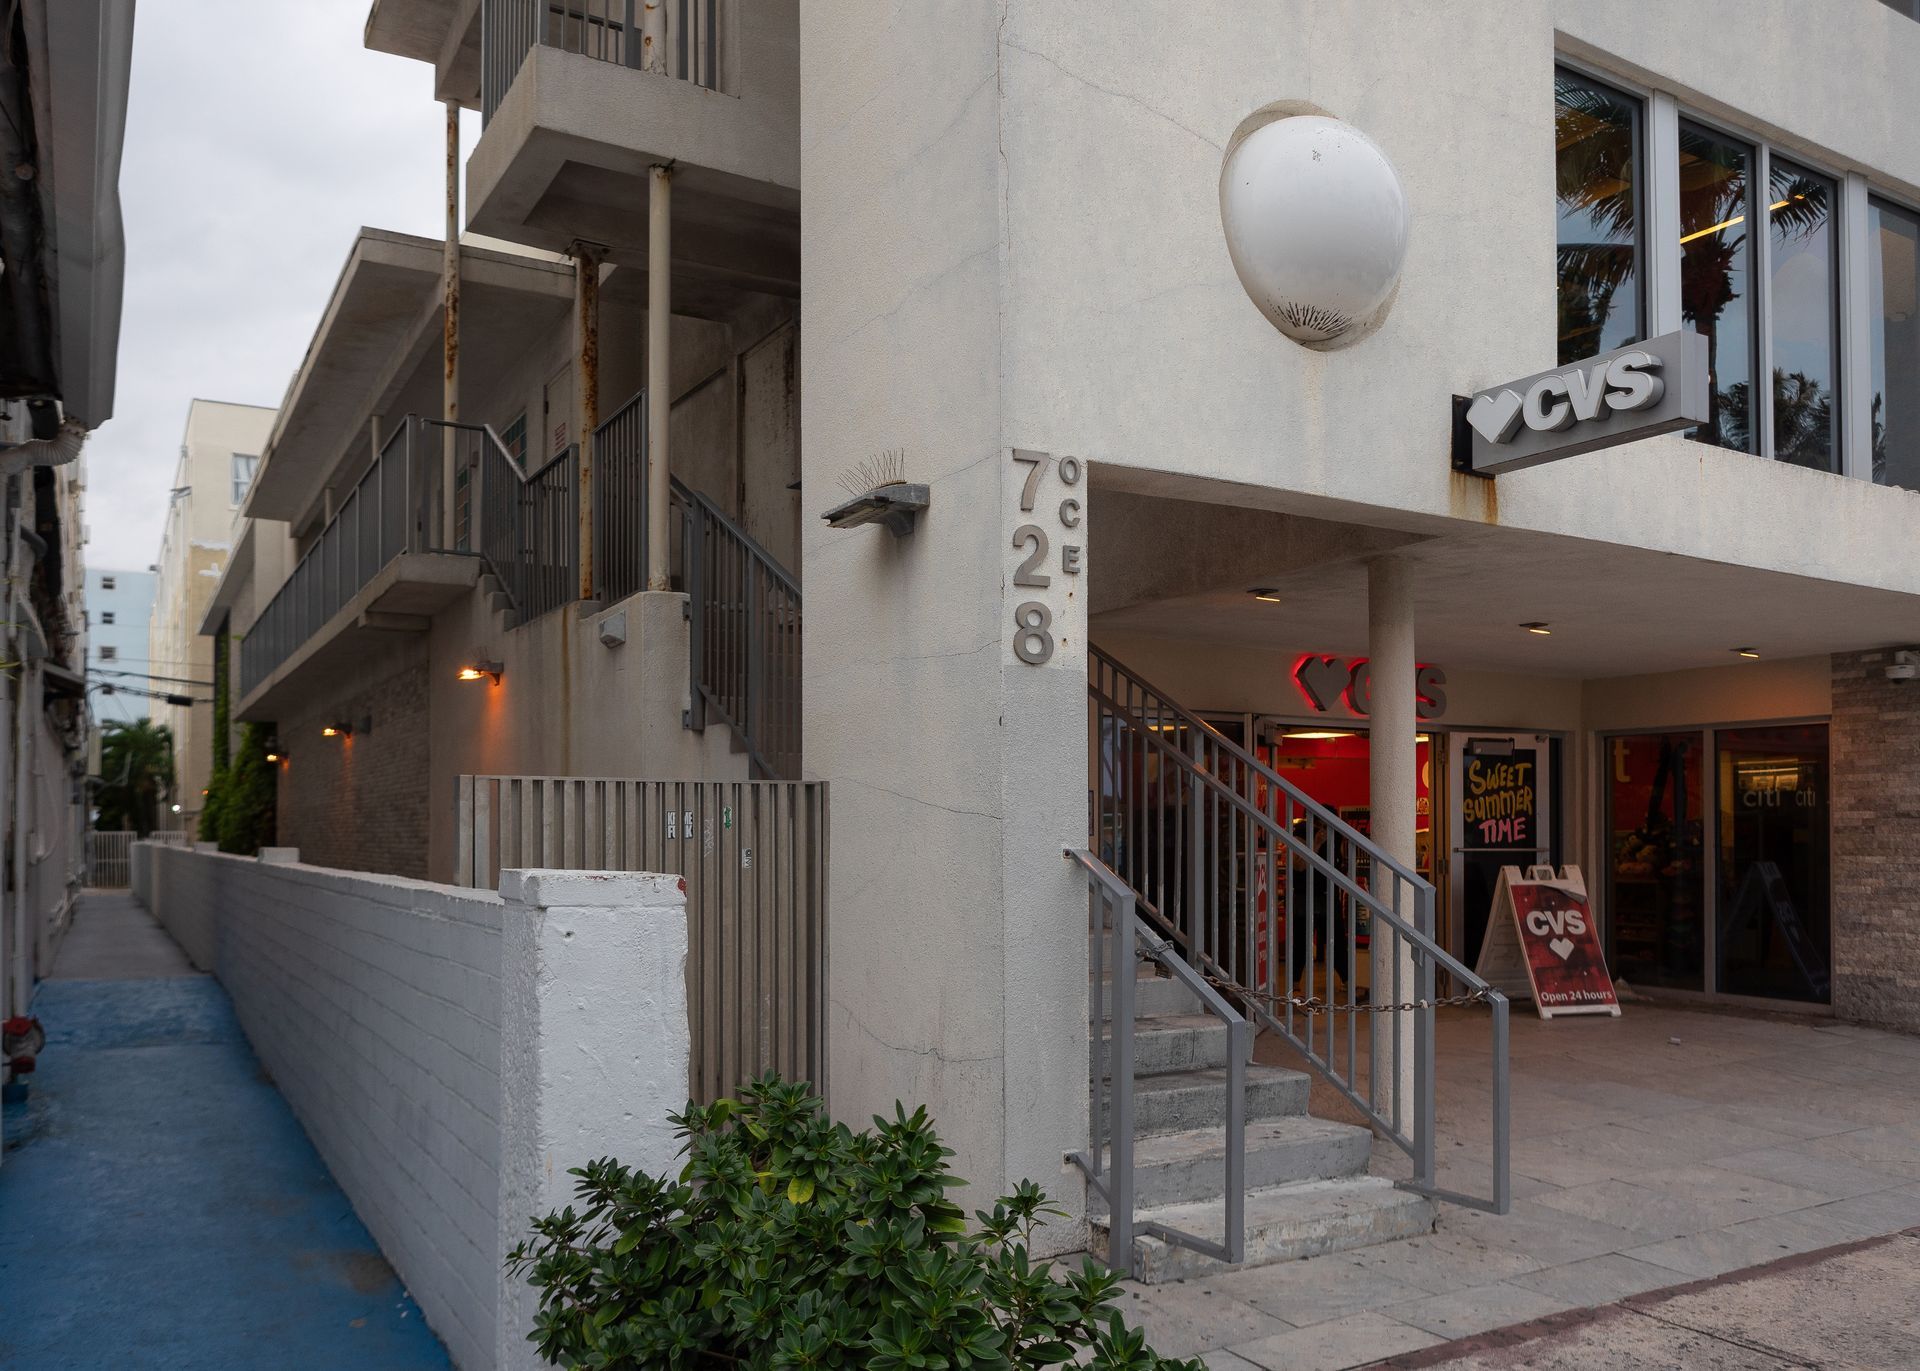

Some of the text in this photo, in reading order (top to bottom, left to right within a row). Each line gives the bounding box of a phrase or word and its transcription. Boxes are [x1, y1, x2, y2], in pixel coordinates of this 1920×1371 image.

[1523, 351, 1662, 431] CVS
[1013, 449, 1054, 664] 728
[1351, 662, 1447, 718] CS
[1469, 760, 1532, 795] SWEET
[1463, 786, 1533, 823] SUMMER
[1479, 817, 1527, 843] TIME
[1526, 910, 1587, 936] CVS
[1541, 989, 1613, 1004] Open 24 hours
